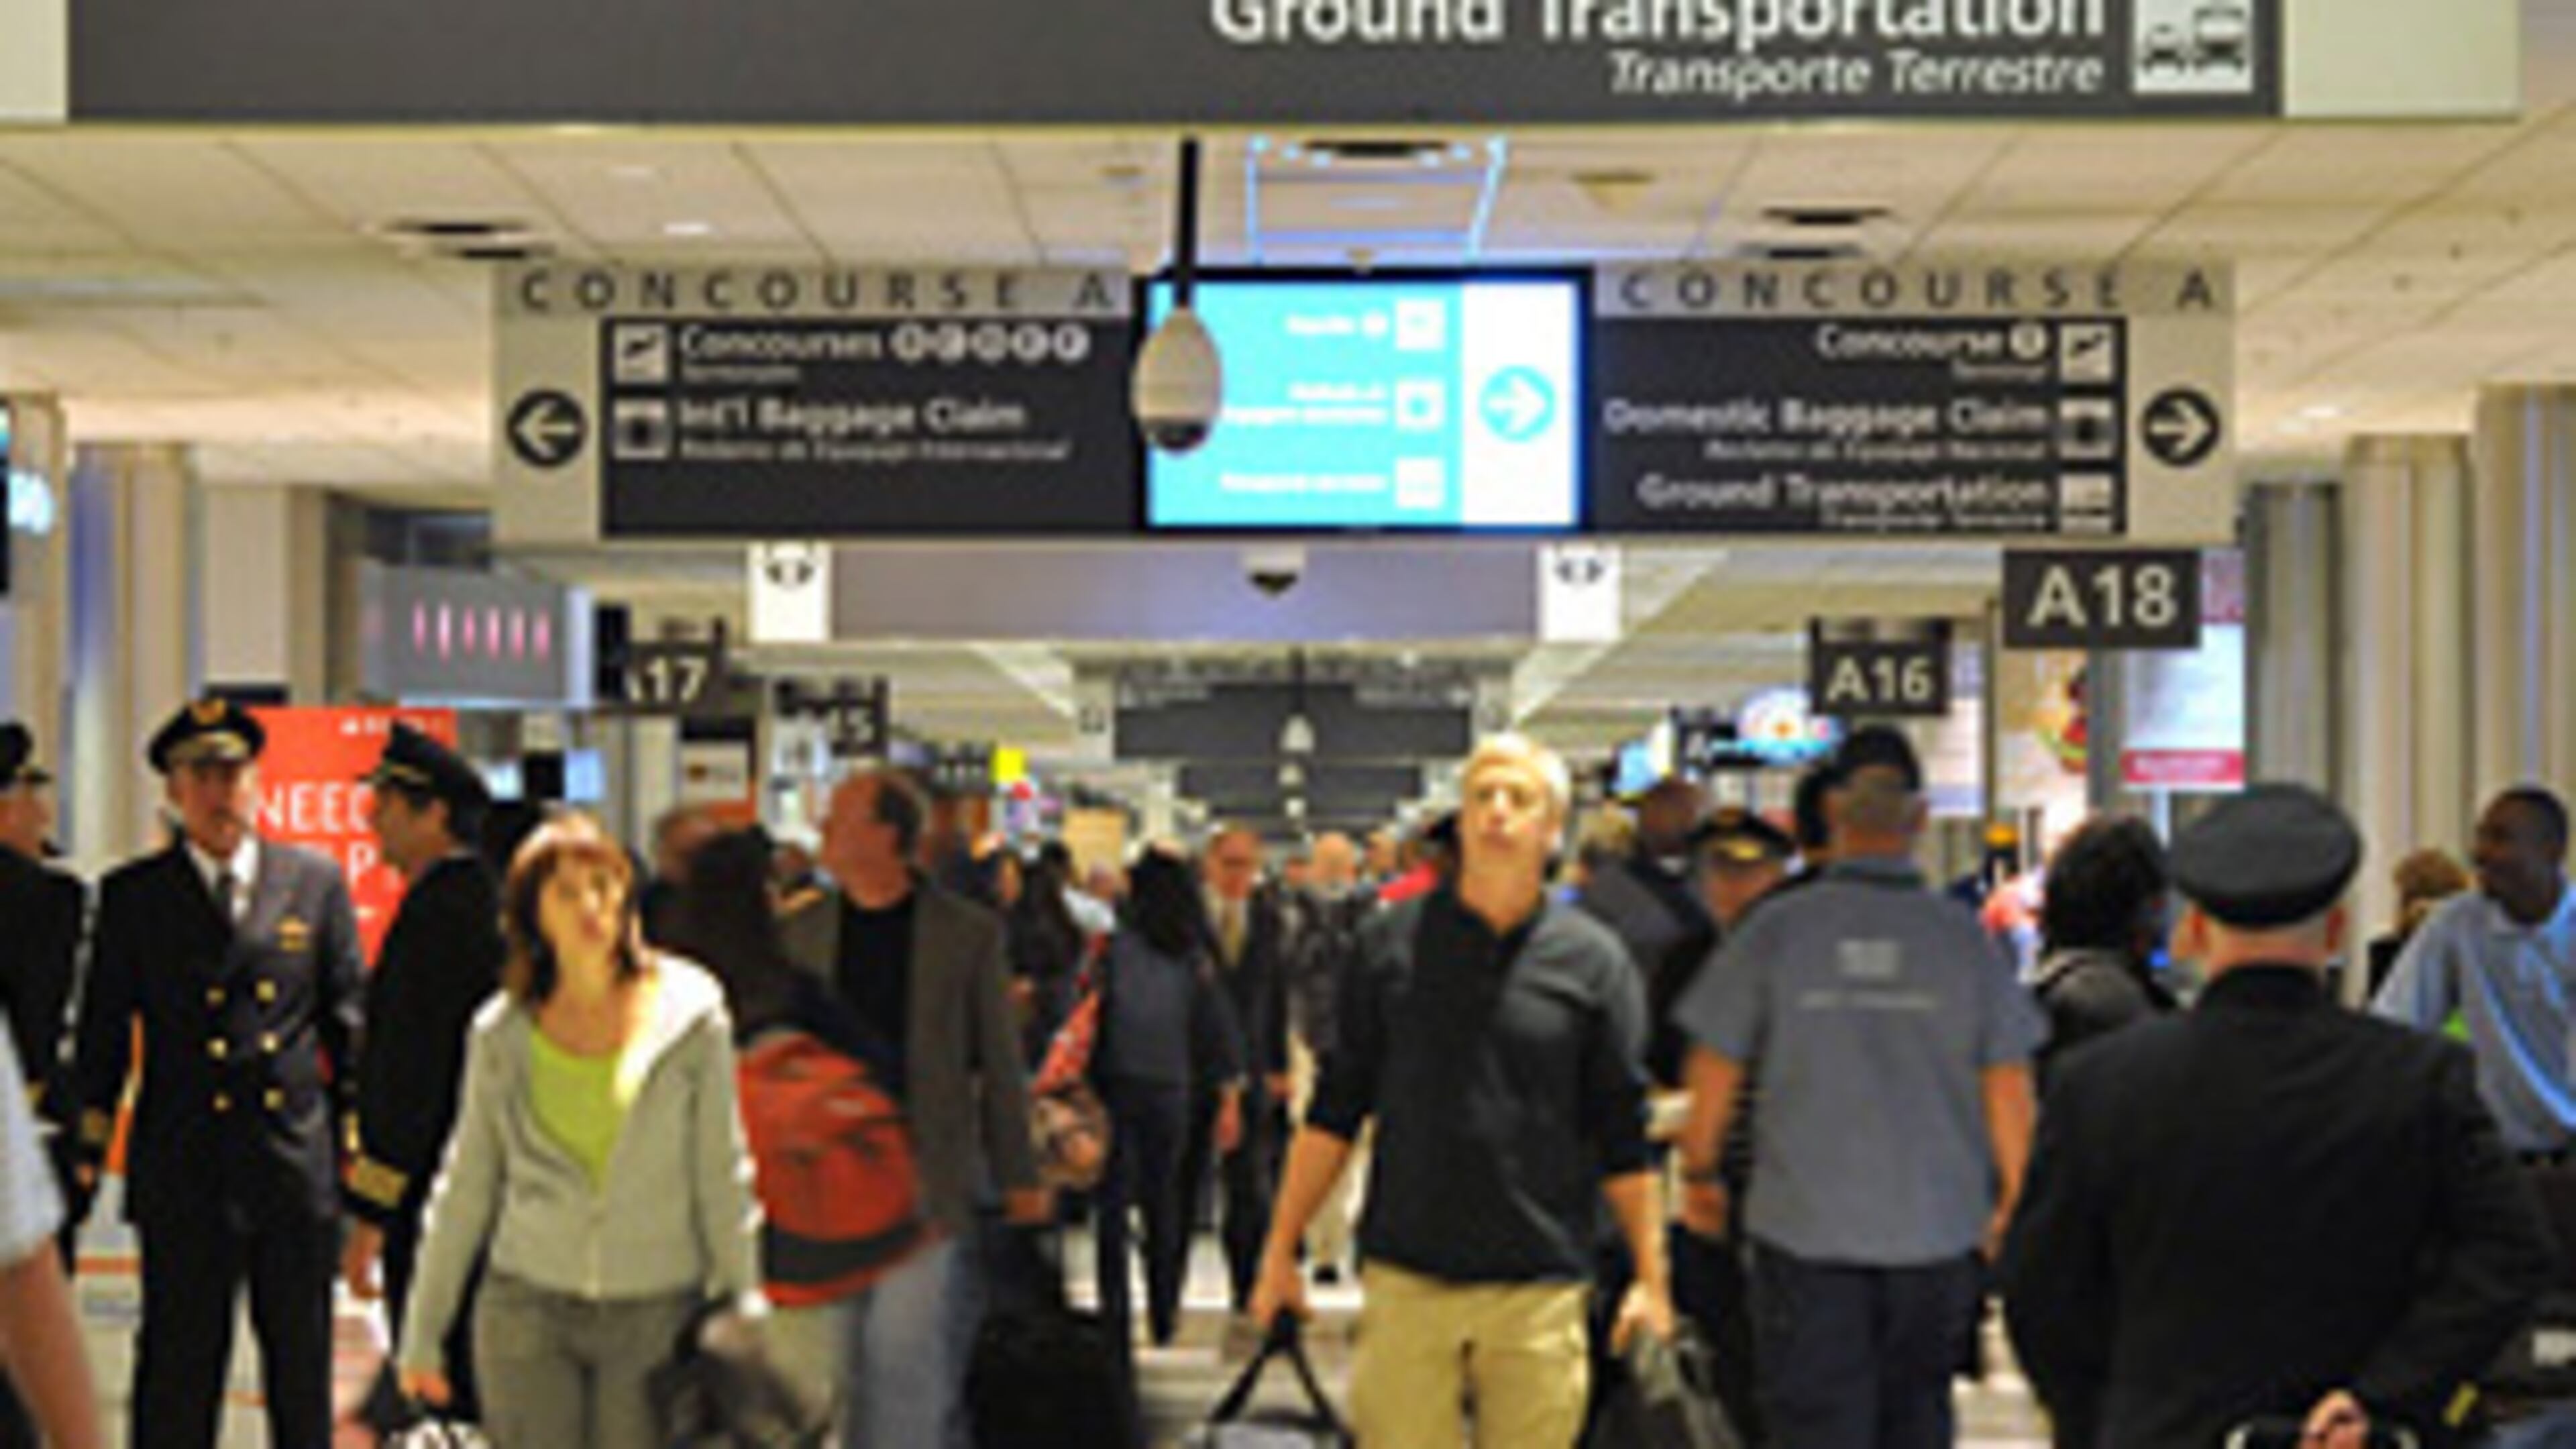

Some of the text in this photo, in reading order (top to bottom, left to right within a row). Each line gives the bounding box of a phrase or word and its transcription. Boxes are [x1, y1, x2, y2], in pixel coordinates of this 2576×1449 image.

[1210, 0, 2105, 51] Ground Transportation
[1611, 50, 2104, 101] Transporte Terrestre
[521, 272, 1114, 310] CONCOURSE A
[1621, 272, 2214, 309] CONCOURSE A
[680, 323, 883, 360] Concourses
[1815, 323, 2004, 359] Concourse
[758, 400, 915, 436] Baggage
[923, 398, 1026, 432] Claim
[1603, 398, 2047, 436] Domestic Baggage Claim
[1637, 472, 2047, 514] Ground Transportation
[2026, 564, 2179, 628] A18
[1826, 656, 1933, 702] A16
